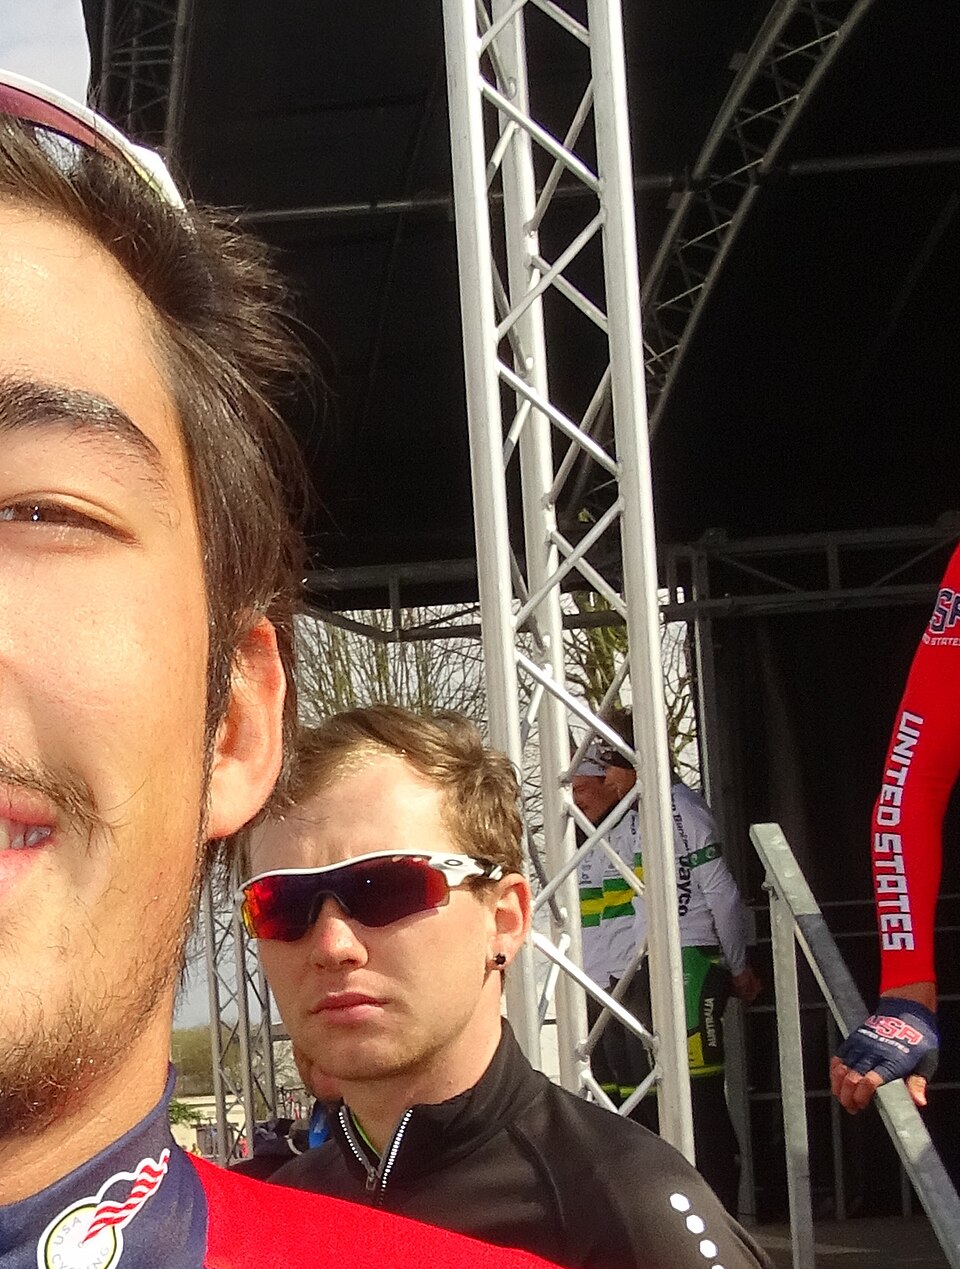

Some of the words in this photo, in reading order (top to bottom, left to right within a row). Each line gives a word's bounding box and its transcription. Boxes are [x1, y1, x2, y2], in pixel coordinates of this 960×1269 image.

[876, 710, 924, 827] UNITED
[874, 832, 915, 951] STATES
[864, 1015, 924, 1046] USA
[53, 1216, 82, 1246] USA
